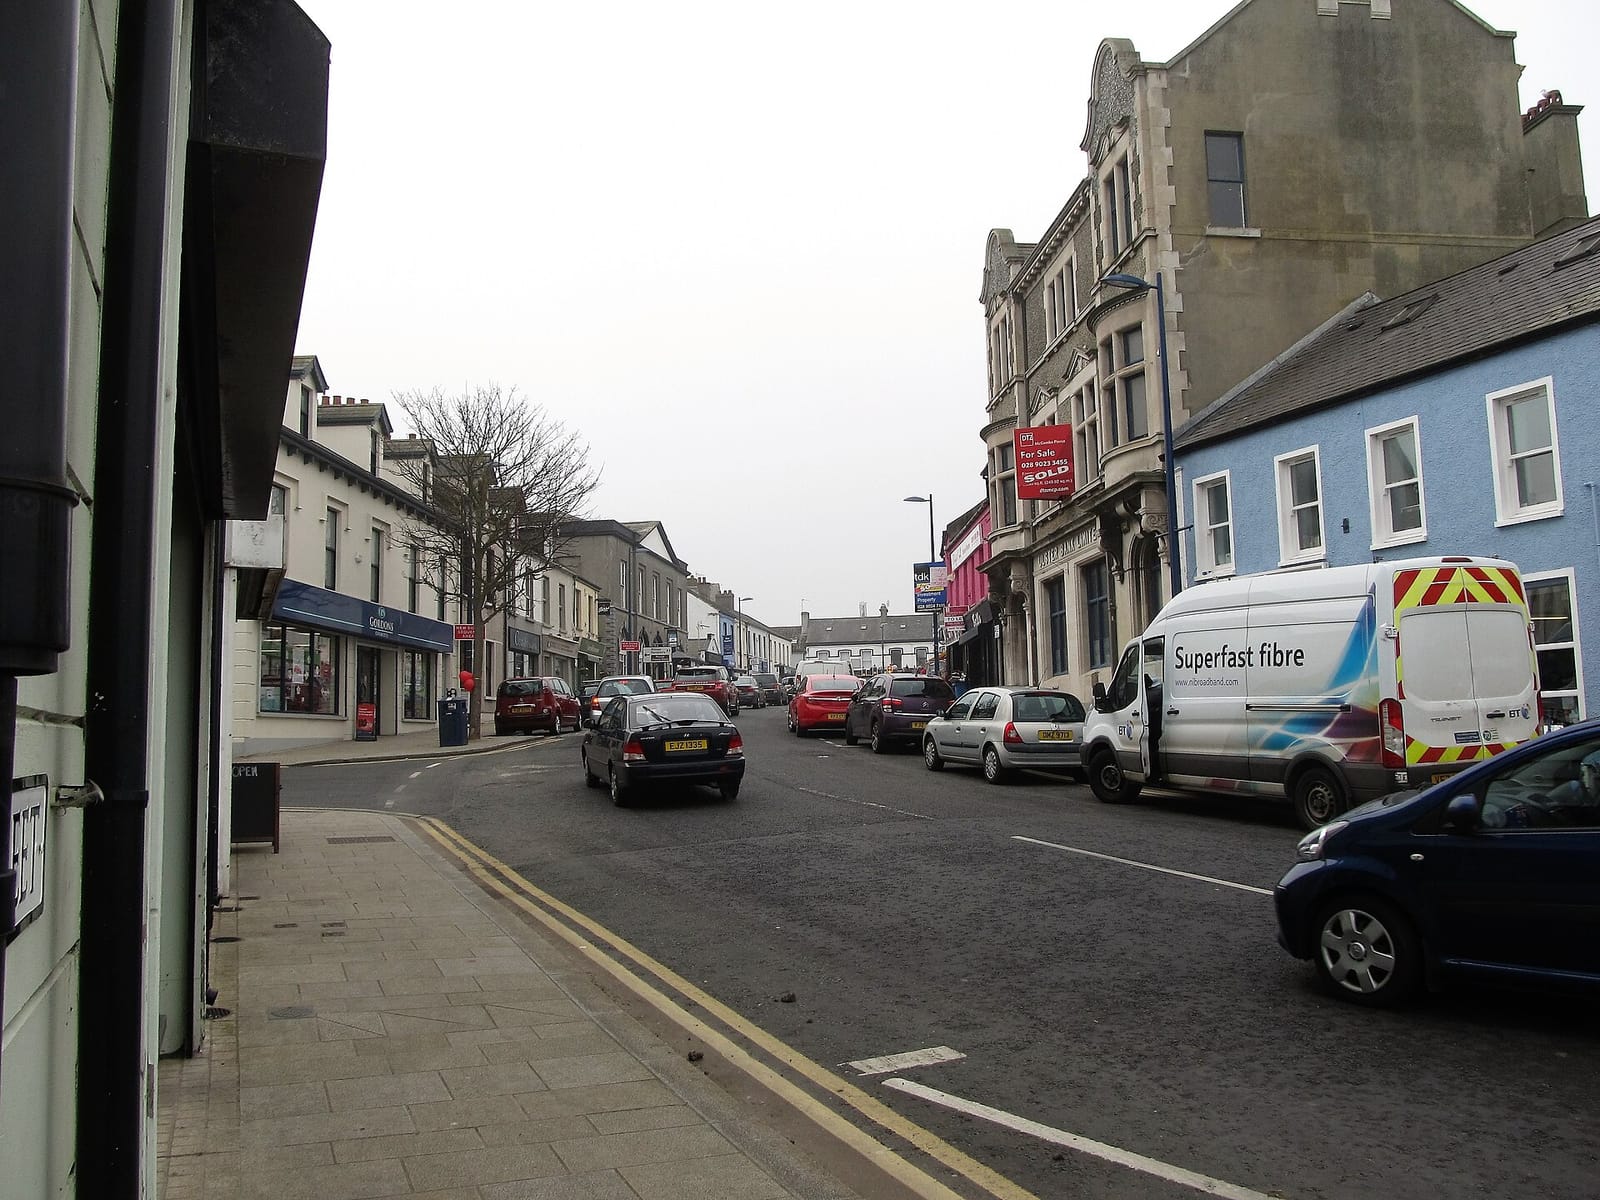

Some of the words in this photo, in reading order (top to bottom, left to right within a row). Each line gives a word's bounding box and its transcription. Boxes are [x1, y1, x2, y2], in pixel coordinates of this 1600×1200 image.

[1021, 434, 1033, 442] DTZ
[1020, 451, 1035, 459] For
[1036, 448, 1056, 458] Sale
[1023, 465, 1070, 483] SOLD
[1037, 547, 1058, 568] ULSTER
[1059, 538, 1075, 557] BANK
[1075, 528, 1098, 548] LIMITE
[914, 572, 930, 581] tdk
[369, 616, 394, 631] GORDONS
[1175, 644, 1254, 674] Superfast
[1260, 642, 1305, 667] fibre
[1175, 677, 1239, 687] www.nibroadband.com
[1509, 709, 1521, 718] BT
[1118, 725, 1126, 736] BT
[232, 766, 258, 777] OPEN
